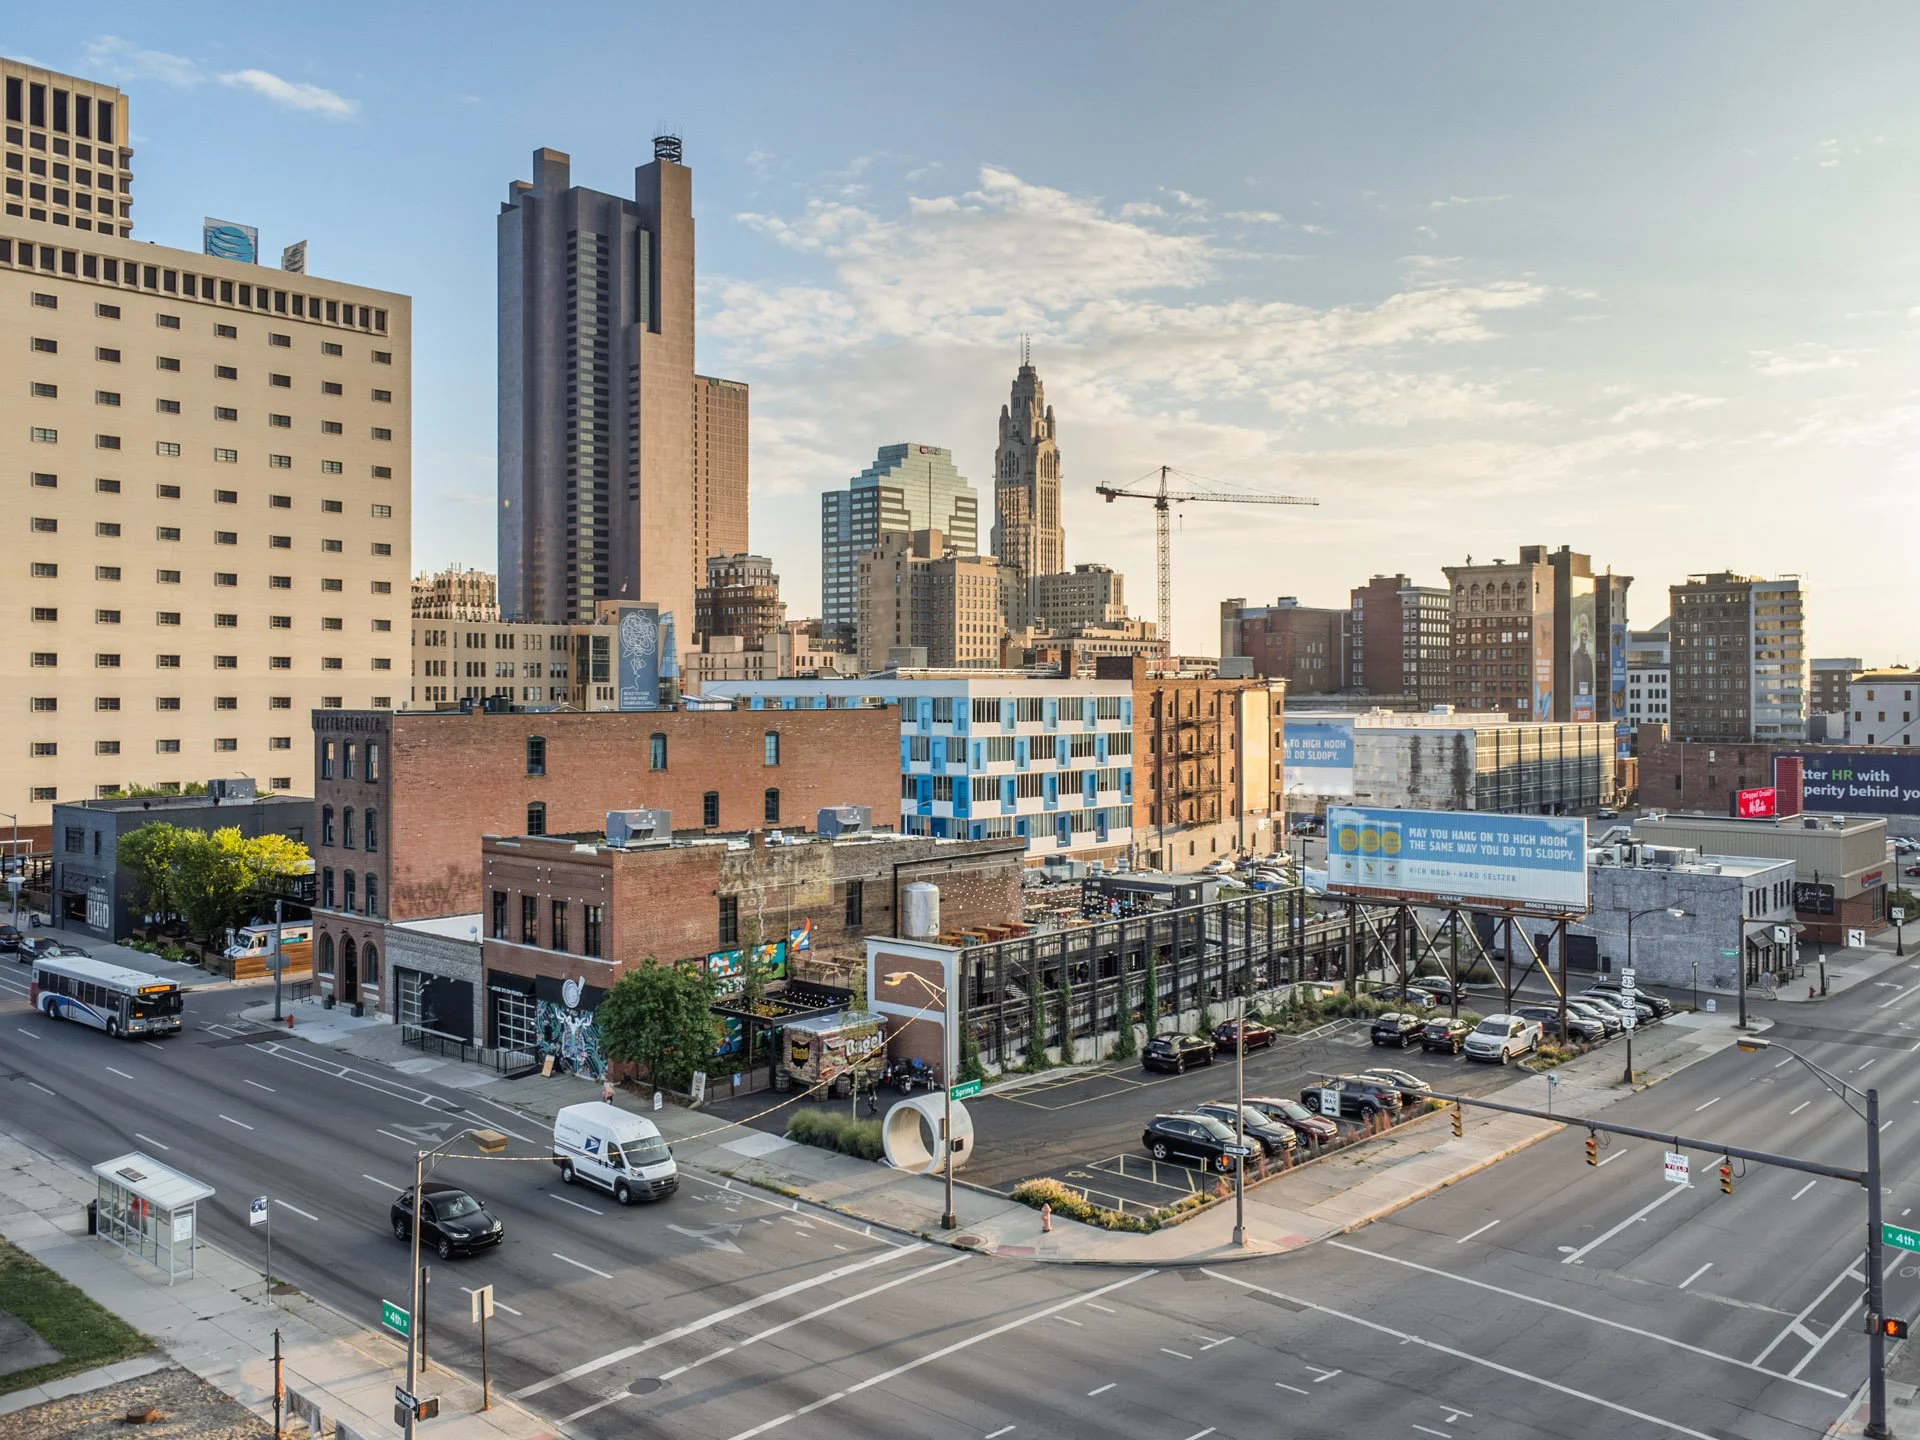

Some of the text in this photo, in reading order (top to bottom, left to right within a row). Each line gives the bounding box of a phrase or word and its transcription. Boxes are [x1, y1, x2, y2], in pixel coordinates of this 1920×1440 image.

[1290, 739, 1299, 748] TO
[1303, 740, 1320, 748] HIGH
[1324, 740, 1346, 749] NOON
[1832, 770, 1852, 780] HR
[1857, 770, 1890, 782] with
[1804, 784, 1845, 799] perity
[1850, 784, 1898, 798] behind
[1409, 828, 1568, 847] MAY YOU HANG ON TO HIGH NOON
[1408, 840, 1426, 850] THE
[1430, 841, 1454, 852] SAME
[1457, 844, 1477, 854] WAY
[1480, 845, 1499, 855] YOU
[1503, 846, 1516, 856] DO
[1520, 848, 1532, 857] TO
[1536, 848, 1576, 860] SLOOPY.
[1624, 978, 1634, 986] 33
[846, 1030, 883, 1056] Bagel
[956, 1086, 974, 1098] Spring
[1669, 1164, 1687, 1172] YIELD
[1896, 1234, 1915, 1246] 4th
[390, 1312, 401, 1326] 4th
